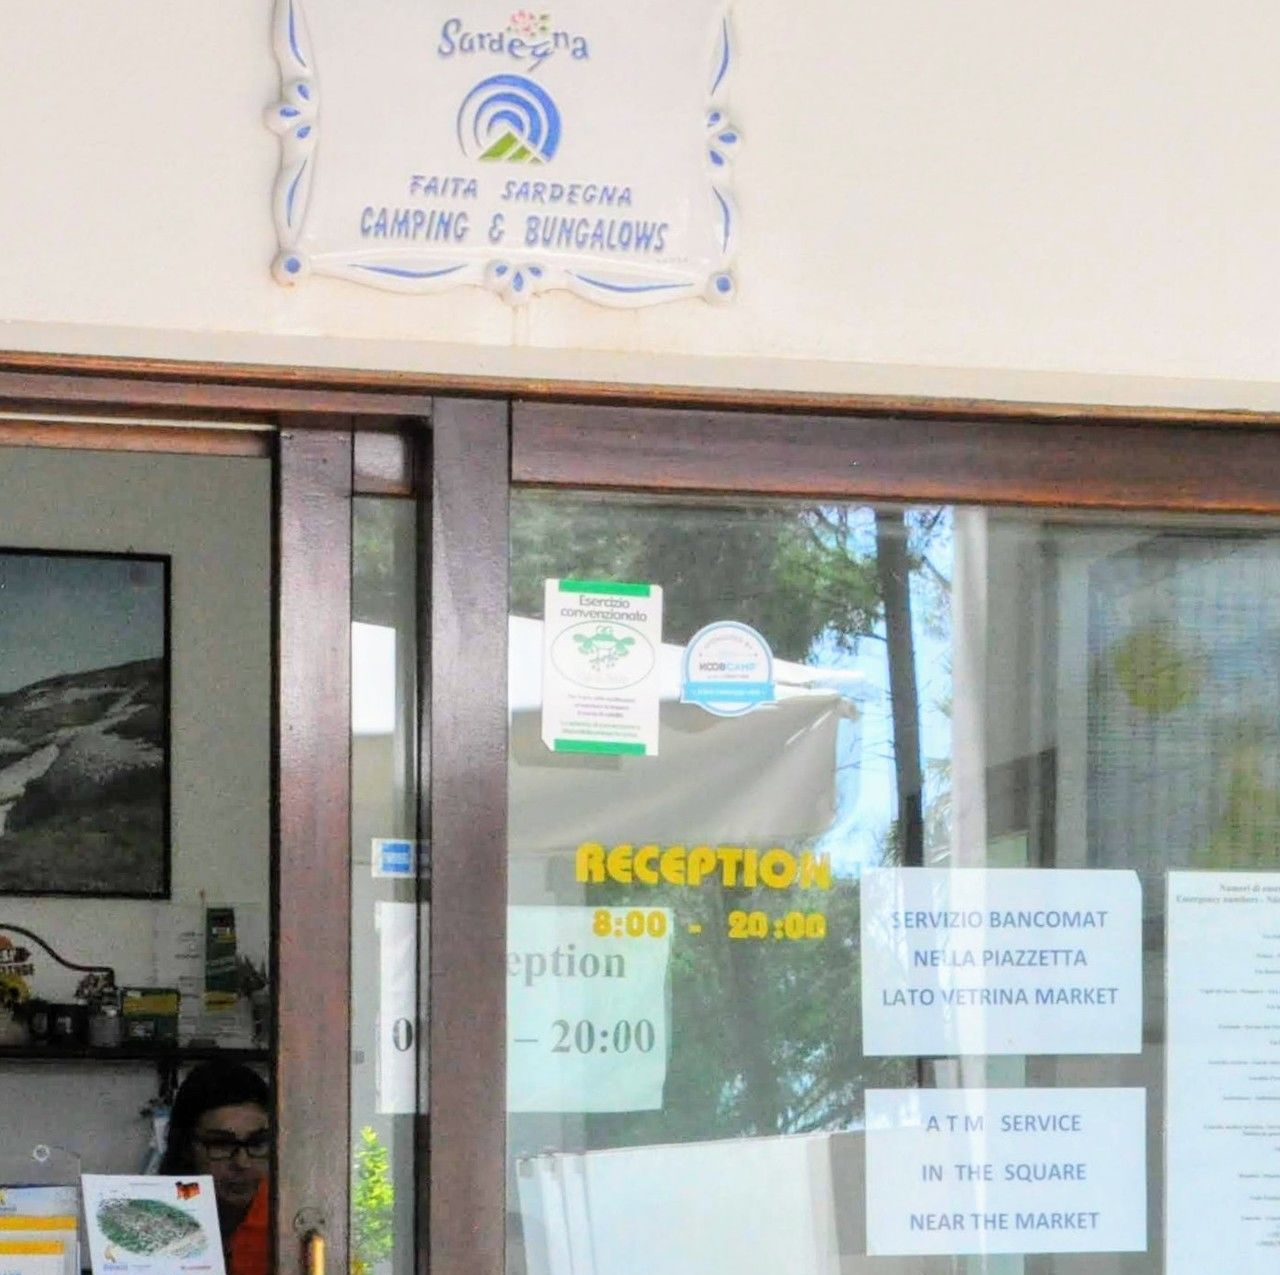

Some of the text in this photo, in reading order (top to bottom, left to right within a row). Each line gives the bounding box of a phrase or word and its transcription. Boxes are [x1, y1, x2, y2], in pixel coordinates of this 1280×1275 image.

[437, 18, 589, 72] Sardegna
[410, 175, 632, 206] FAITA SARDEGNA
[360, 207, 668, 253] CAMPING & BUNGALOWS
[579, 594, 630, 609] Esercizio
[560, 607, 647, 623] convenzionato
[575, 842, 832, 890] RECEPTION
[592, 909, 667, 938] 8:00
[728, 911, 826, 939] 20:00
[892, 911, 1108, 929] SERVIZIO BANCOMAT
[506, 943, 626, 986] eption
[914, 950, 1087, 967] NELA PIAZZETTA
[882, 987, 1118, 1006] LATO VETRINA MARKET
[550, 1018, 656, 1054] 20:00
[1001, 1114, 1081, 1132] SERVICE
[922, 1163, 1087, 1182] IN THE SQUARE
[910, 1212, 1099, 1231] NEAR THE MARKET
